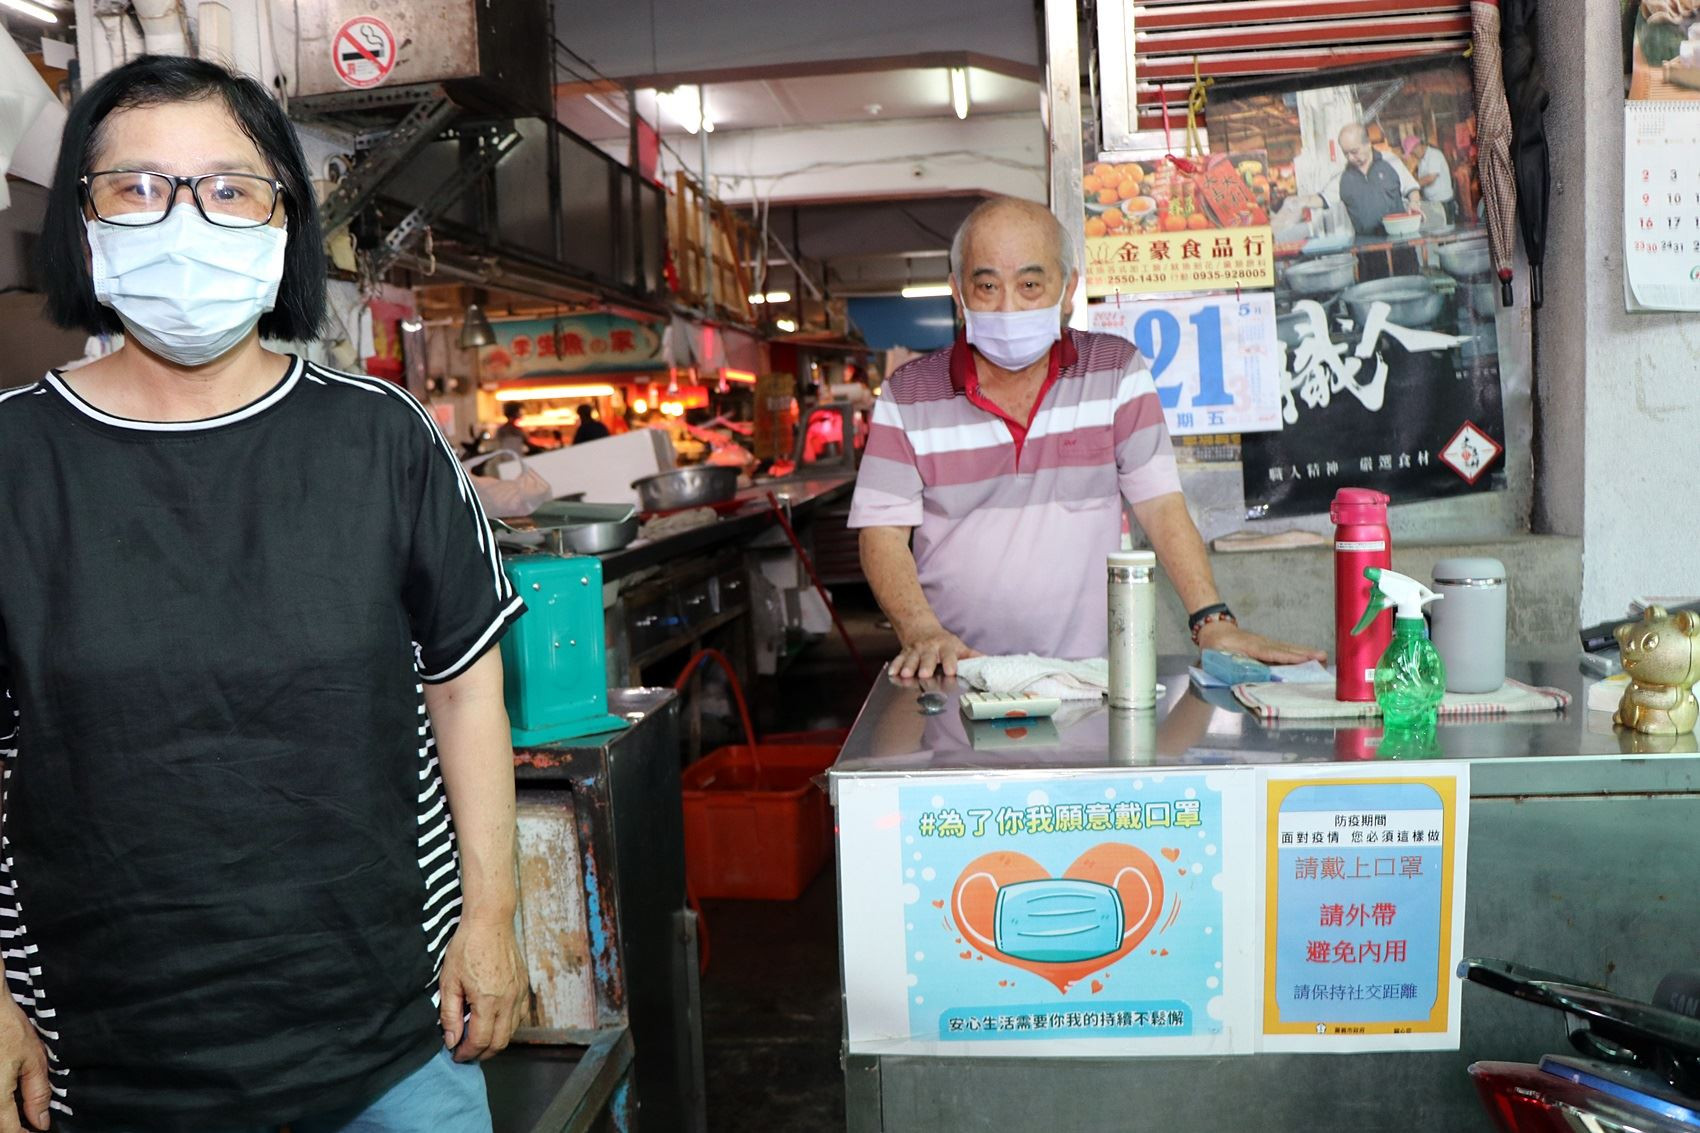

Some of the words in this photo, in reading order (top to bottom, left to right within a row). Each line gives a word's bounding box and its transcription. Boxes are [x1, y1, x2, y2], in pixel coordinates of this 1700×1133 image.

[1642, 169, 1650, 182] 2
[1670, 169, 1677, 181] 3
[1642, 193, 1650, 206] 9
[1667, 193, 1681, 206] 10
[1639, 216, 1653, 230] 16
[1667, 216, 1681, 230] 17
[1117, 234, 1266, 263] 金豪食品行
[1107, 273, 1166, 285] 2550-1430
[1193, 268, 1267, 280] 0935-928005
[1134, 304, 1235, 409] 21
[919, 800, 1202, 838] #為了你我願意戴口罩
[1334, 813, 1387, 828] 防疫期間
[1281, 831, 1340, 845] 面對疫情
[1351, 829, 1441, 843] 您必須這樣做
[1295, 855, 1424, 880] 請戴上口罩
[1320, 902, 1397, 928] 請外帶
[1306, 939, 1407, 964] 避免內用
[1293, 983, 1418, 1000] 請保持社交距離
[949, 1010, 1185, 1032] 安心生活需要你我的持續不鬆懈
